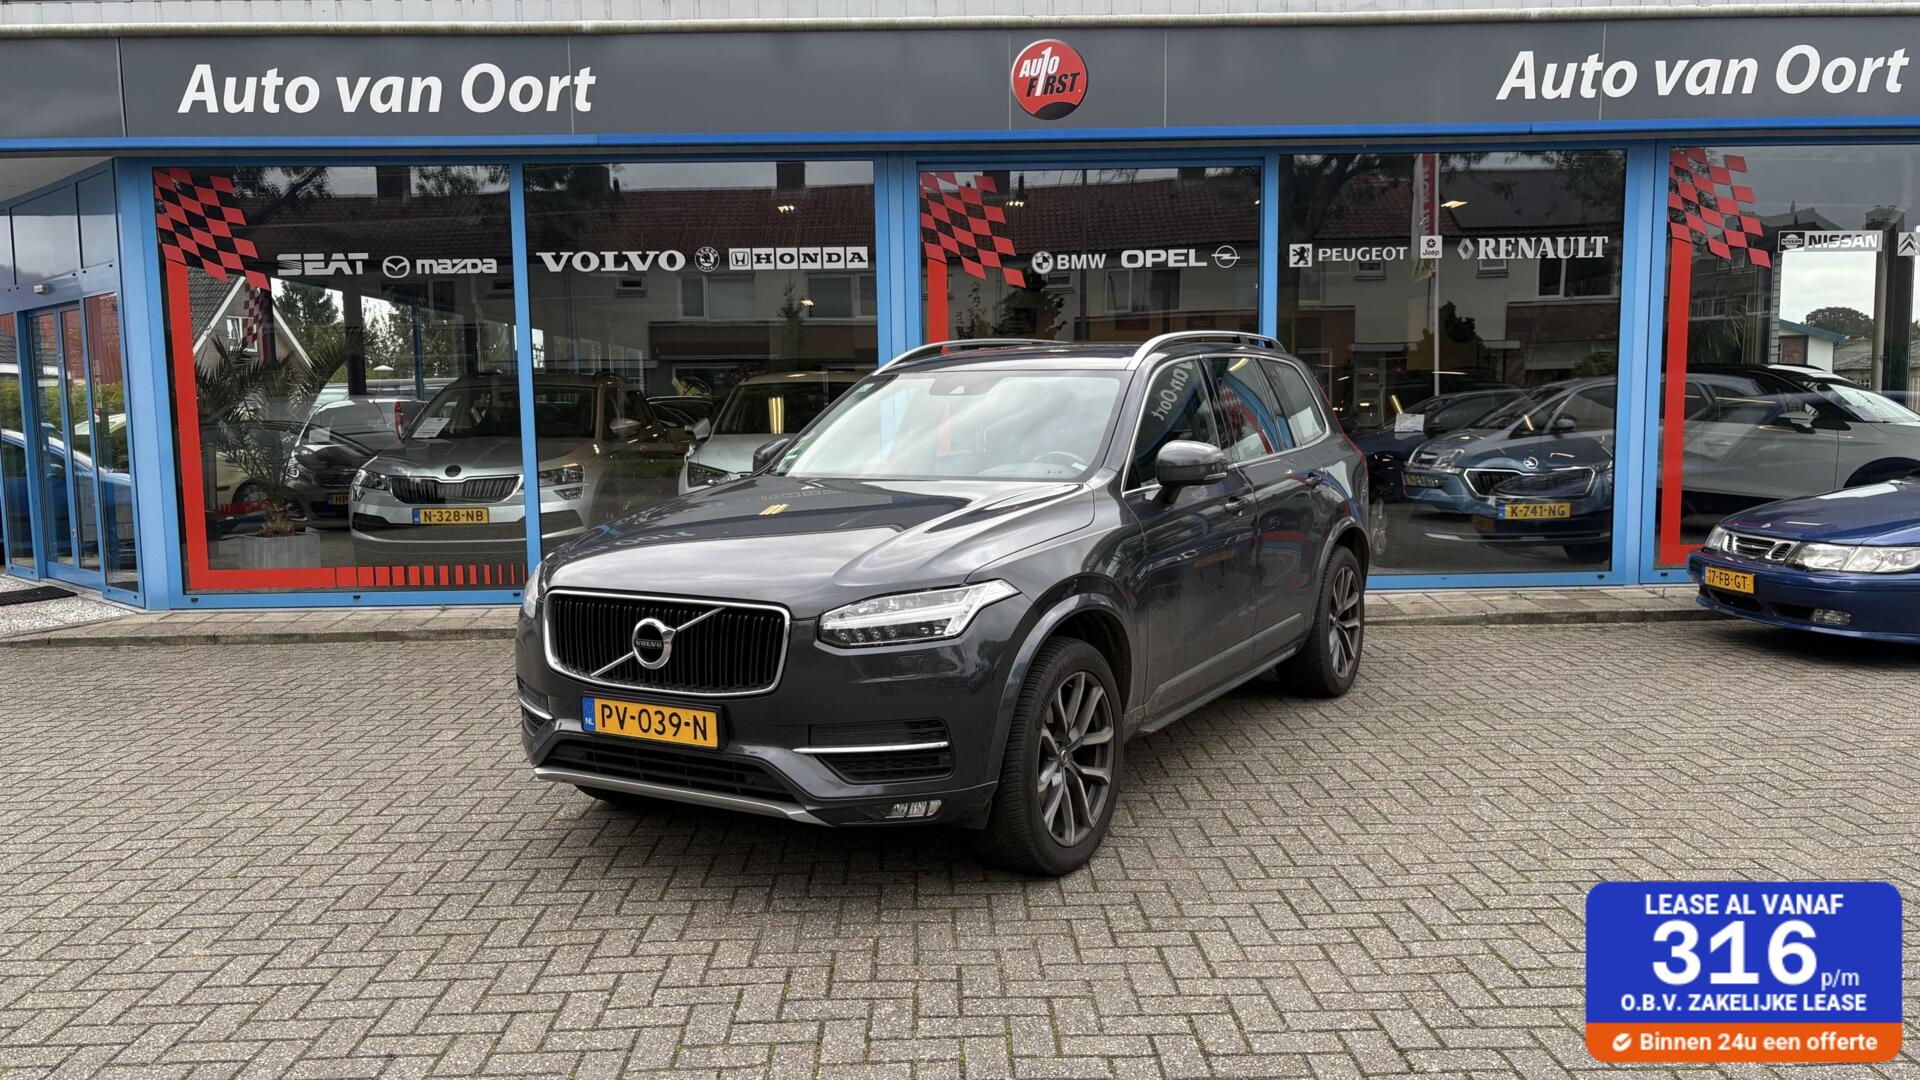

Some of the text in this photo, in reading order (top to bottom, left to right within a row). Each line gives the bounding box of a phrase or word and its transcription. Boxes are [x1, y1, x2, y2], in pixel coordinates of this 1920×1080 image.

[1496, 45, 1909, 100] Auto van Oort
[178, 63, 596, 113] Auto van Oort
[1477, 237, 1609, 260] RENAULT
[1808, 234, 1878, 248] NISSAN
[540, 250, 686, 273] VOLVO
[754, 252, 867, 265] HONDA
[1121, 249, 1208, 268] OPEL
[1318, 247, 1408, 262] PEUGEOT
[1422, 249, 1440, 257] Jeep
[277, 252, 369, 276] SEAT
[416, 258, 498, 275] mazda
[1056, 254, 1106, 270] BMW
[423, 510, 484, 522] N-328-NB
[1510, 505, 1565, 517] K-741-NG
[1708, 568, 1748, 590] 17-FB-GT
[635, 640, 663, 648] VOLVO
[600, 703, 708, 741] PV-039-N
